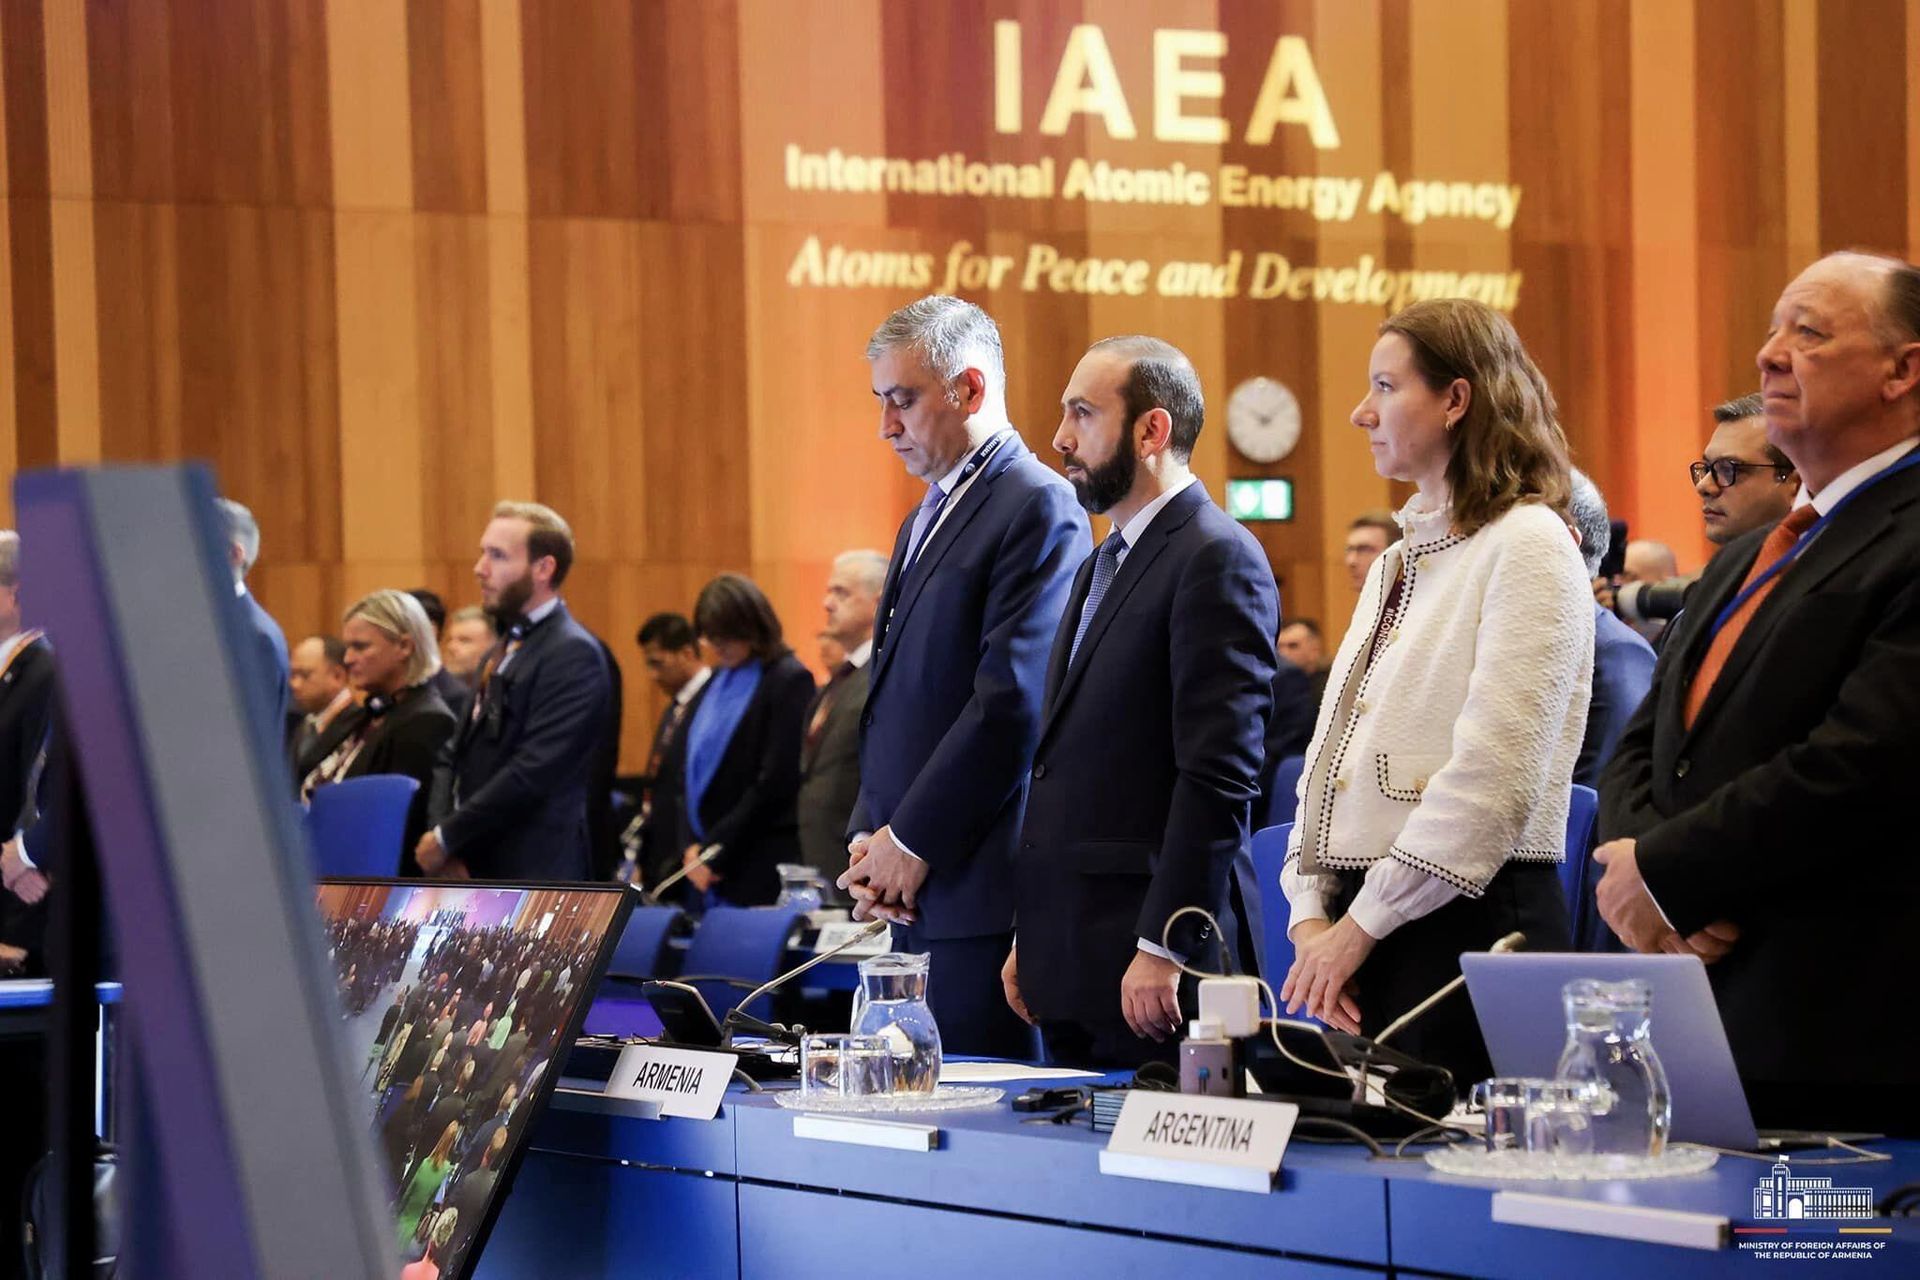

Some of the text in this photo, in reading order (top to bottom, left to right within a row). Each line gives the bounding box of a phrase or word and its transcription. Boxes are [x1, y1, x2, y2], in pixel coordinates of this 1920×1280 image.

[994, 20, 1340, 149] IAEA
[785, 143, 1522, 229] International Atomic Energy Agency
[787, 235, 1522, 314] Atoms for Peace and Development
[632, 1061, 704, 1095] ARMENIA
[1142, 1109, 1255, 1153] ARGENTINA
